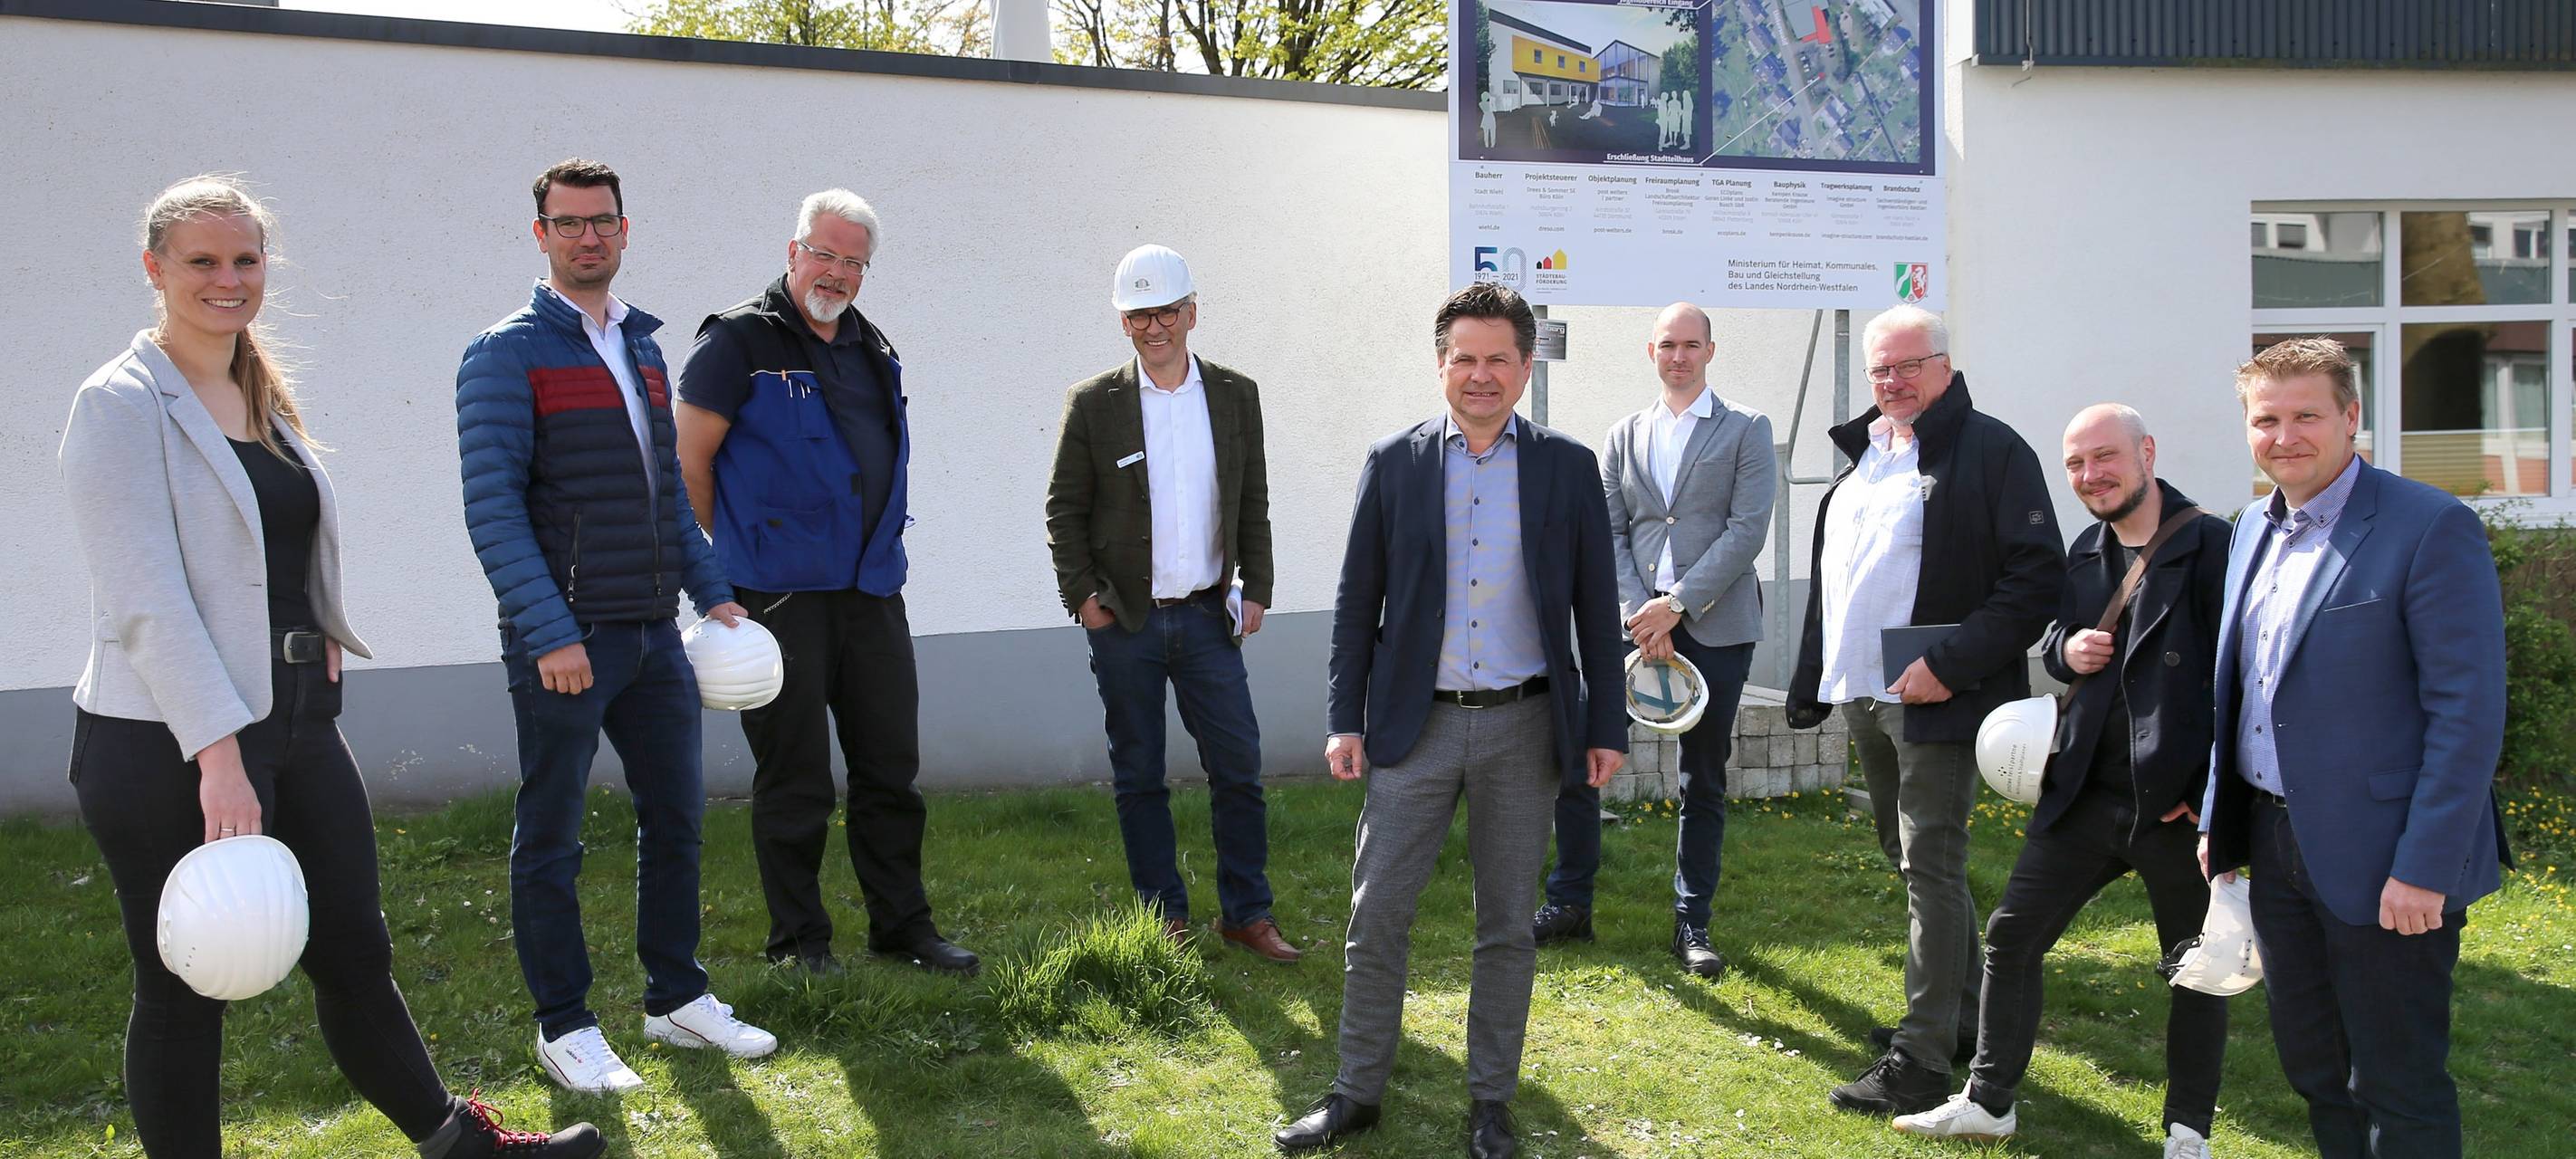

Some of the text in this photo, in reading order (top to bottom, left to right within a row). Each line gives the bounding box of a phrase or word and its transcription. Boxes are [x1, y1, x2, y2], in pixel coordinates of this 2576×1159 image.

[1606, 153, 1694, 163] Erschließung Stadtteilhaus
[1474, 171, 1503, 179] Bauherr
[1525, 173, 1578, 182] Projektsteuerer
[1587, 175, 1638, 185] Objektplanung
[1645, 177, 1700, 187] Freiraumplanung
[1725, 179, 1752, 188] Planung
[1774, 180, 1806, 189] Bauphysik
[1820, 182, 1873, 191] Tragwerksplanung
[1883, 185, 1920, 193] Brandschutz
[1728, 260, 1879, 272] Ministerium für Heimat, Kommunales,
[1474, 273, 1489, 281] 1971
[1503, 273, 1519, 281] 2021
[1728, 271, 1821, 282] Bau und Gleichstellung
[1728, 283, 1859, 292] des Landes Nordrhein-Westfalen
